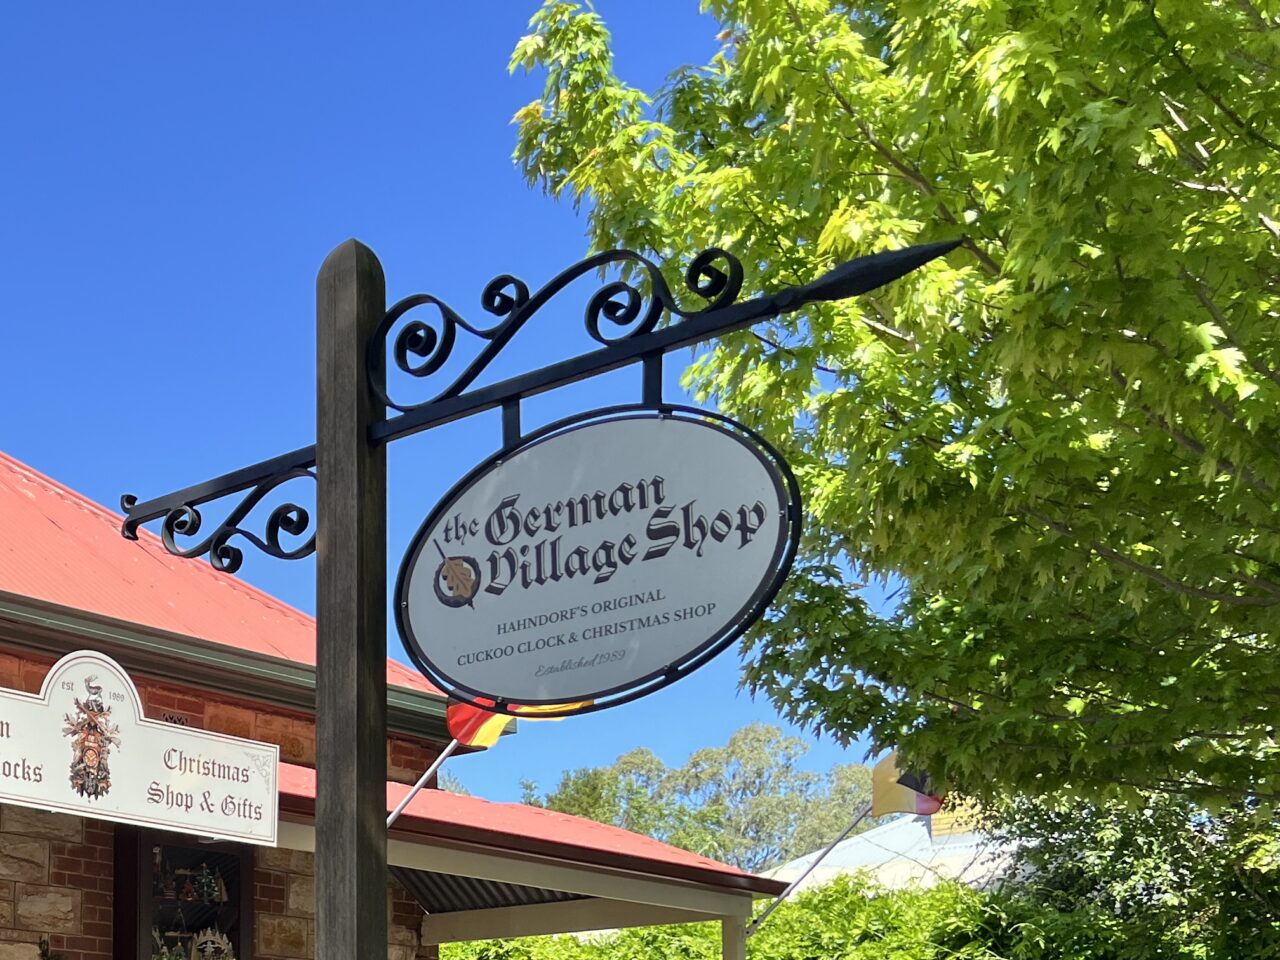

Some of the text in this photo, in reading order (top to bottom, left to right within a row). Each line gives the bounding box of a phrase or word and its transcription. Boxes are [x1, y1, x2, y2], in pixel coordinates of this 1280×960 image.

[443, 474, 665, 546] the German
[484, 499, 767, 596] Village Shop
[457, 602, 717, 667] CUCKOO CLOCK & CHRISTMAS SHOP
[496, 588, 666, 636] HAHNDORF'S ORIGINAL
[535, 655, 597, 678] Established
[163, 747, 250, 784] Christmas
[147, 781, 263, 822] Shop & Gifts
